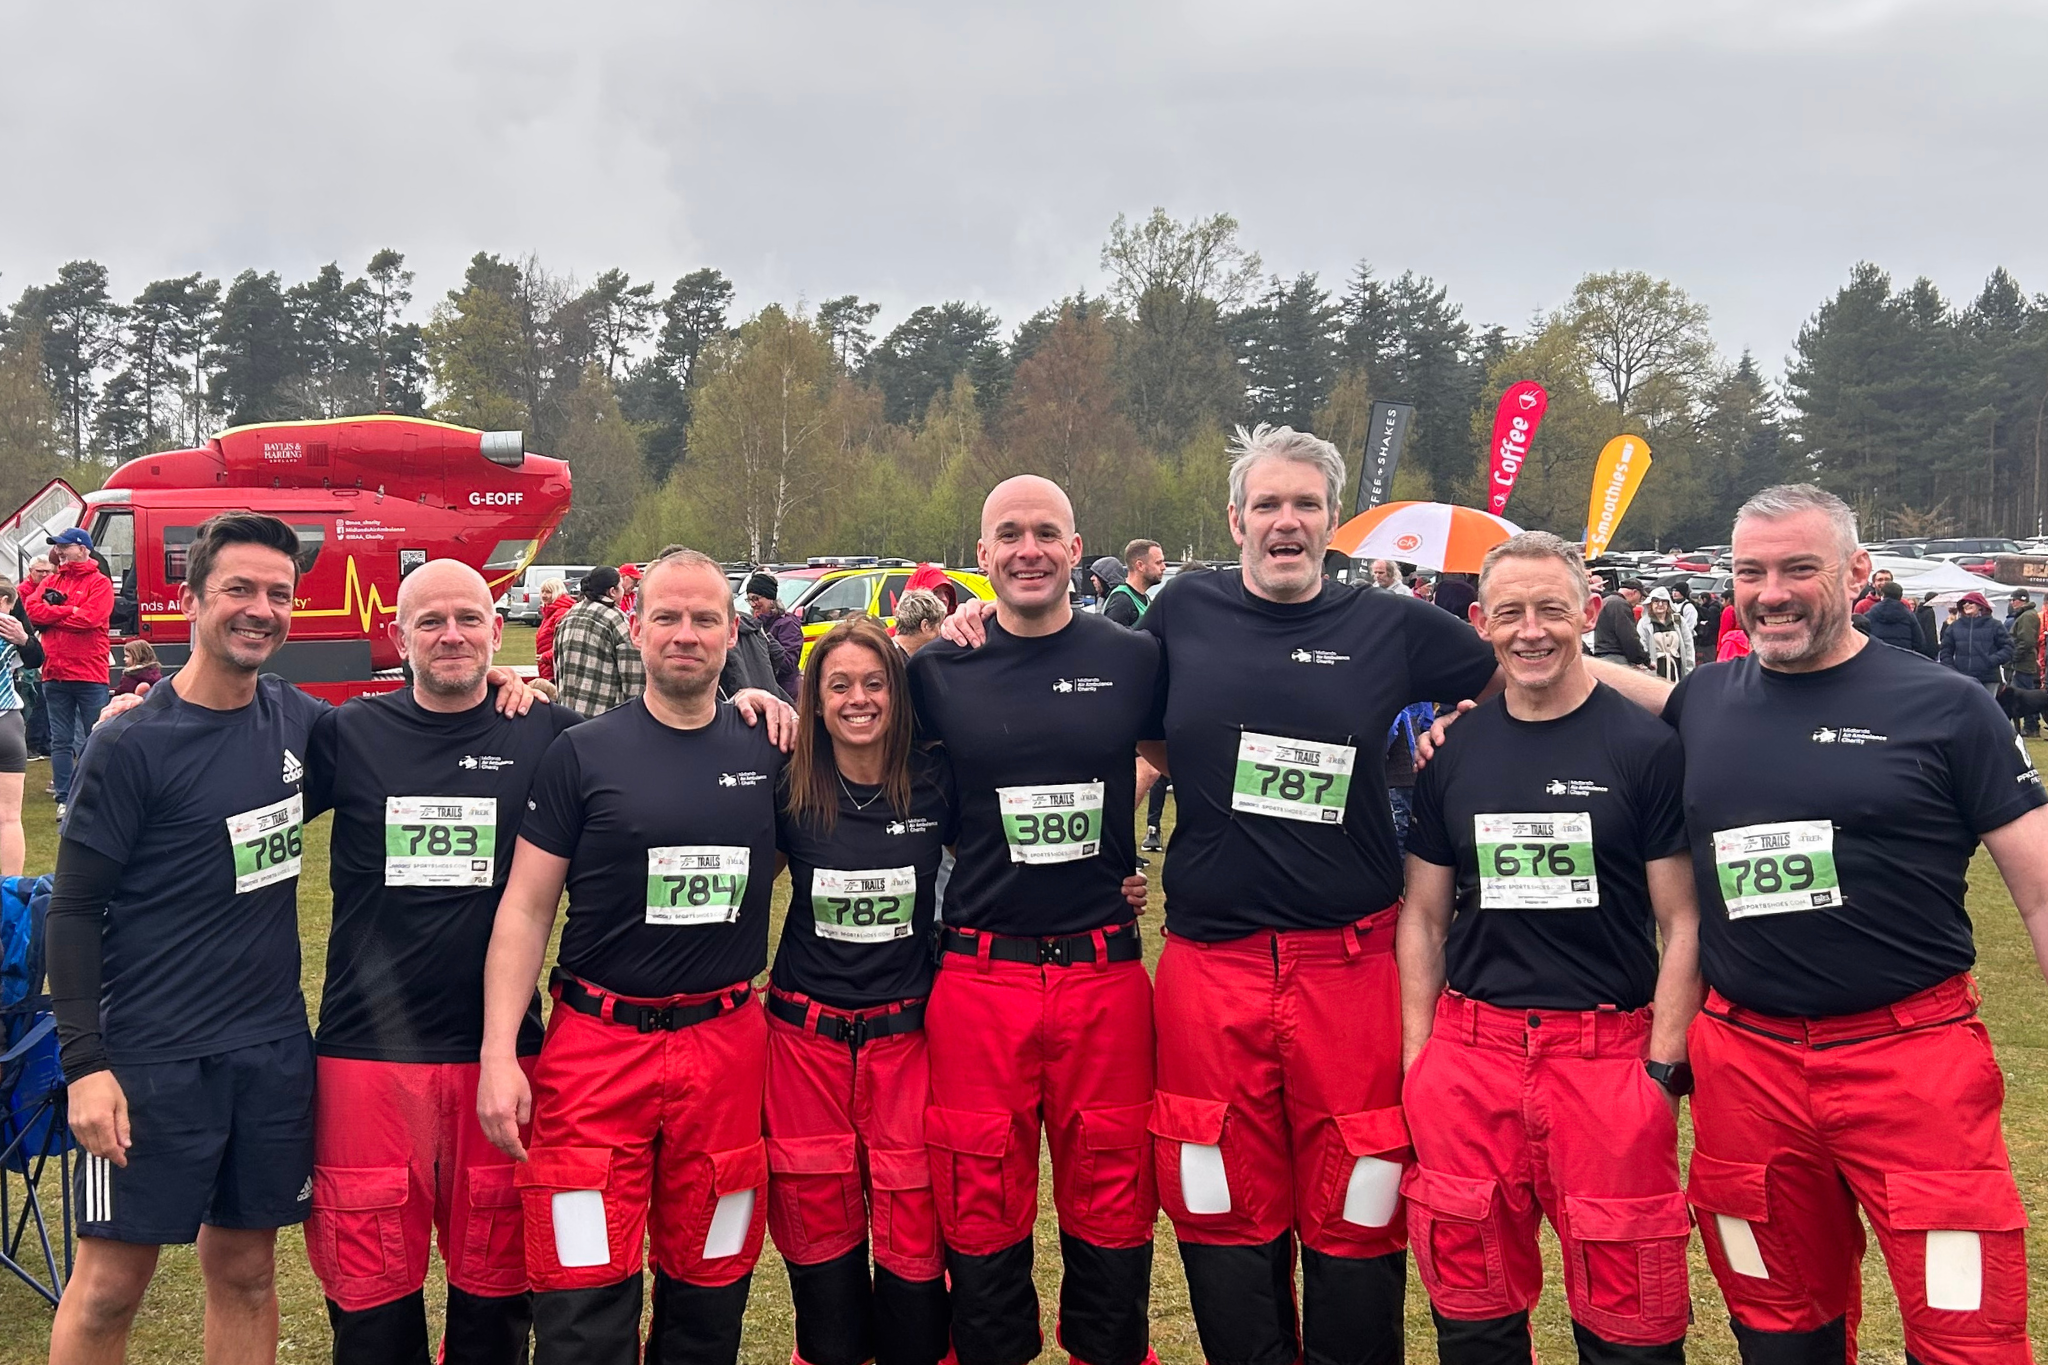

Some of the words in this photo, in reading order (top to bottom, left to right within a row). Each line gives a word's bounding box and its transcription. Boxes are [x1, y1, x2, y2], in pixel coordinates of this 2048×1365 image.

[264, 443, 294, 451] BAYLIS
[295, 443, 302, 451] &
[264, 450, 303, 459] HARDING
[1494, 416, 1529, 486] Coffee
[1369, 479, 1382, 510] FFEE
[1377, 408, 1397, 465] SHAKES
[468, 491, 524, 506] G-EOFF
[1592, 462, 1629, 544] Smoothies
[168, 600, 181, 611] Ai
[1294, 751, 1320, 763] TRAILS
[282, 767, 304, 783] adida
[1255, 763, 1334, 804] 787
[1050, 794, 1075, 805] TRAILS
[271, 809, 289, 825] TRAILS
[437, 807, 463, 818] TRAILS
[1015, 811, 1090, 845] 380
[1531, 824, 1554, 836] TRAILS
[246, 824, 302, 871] 786
[401, 824, 478, 856] 783
[1760, 834, 1790, 849] TRAILS
[697, 856, 720, 867] TRAILS
[1494, 843, 1575, 876] 676
[1728, 853, 1815, 896] 789
[663, 874, 736, 907] 784
[861, 880, 885, 891] TRAILS
[827, 896, 900, 926] 782
